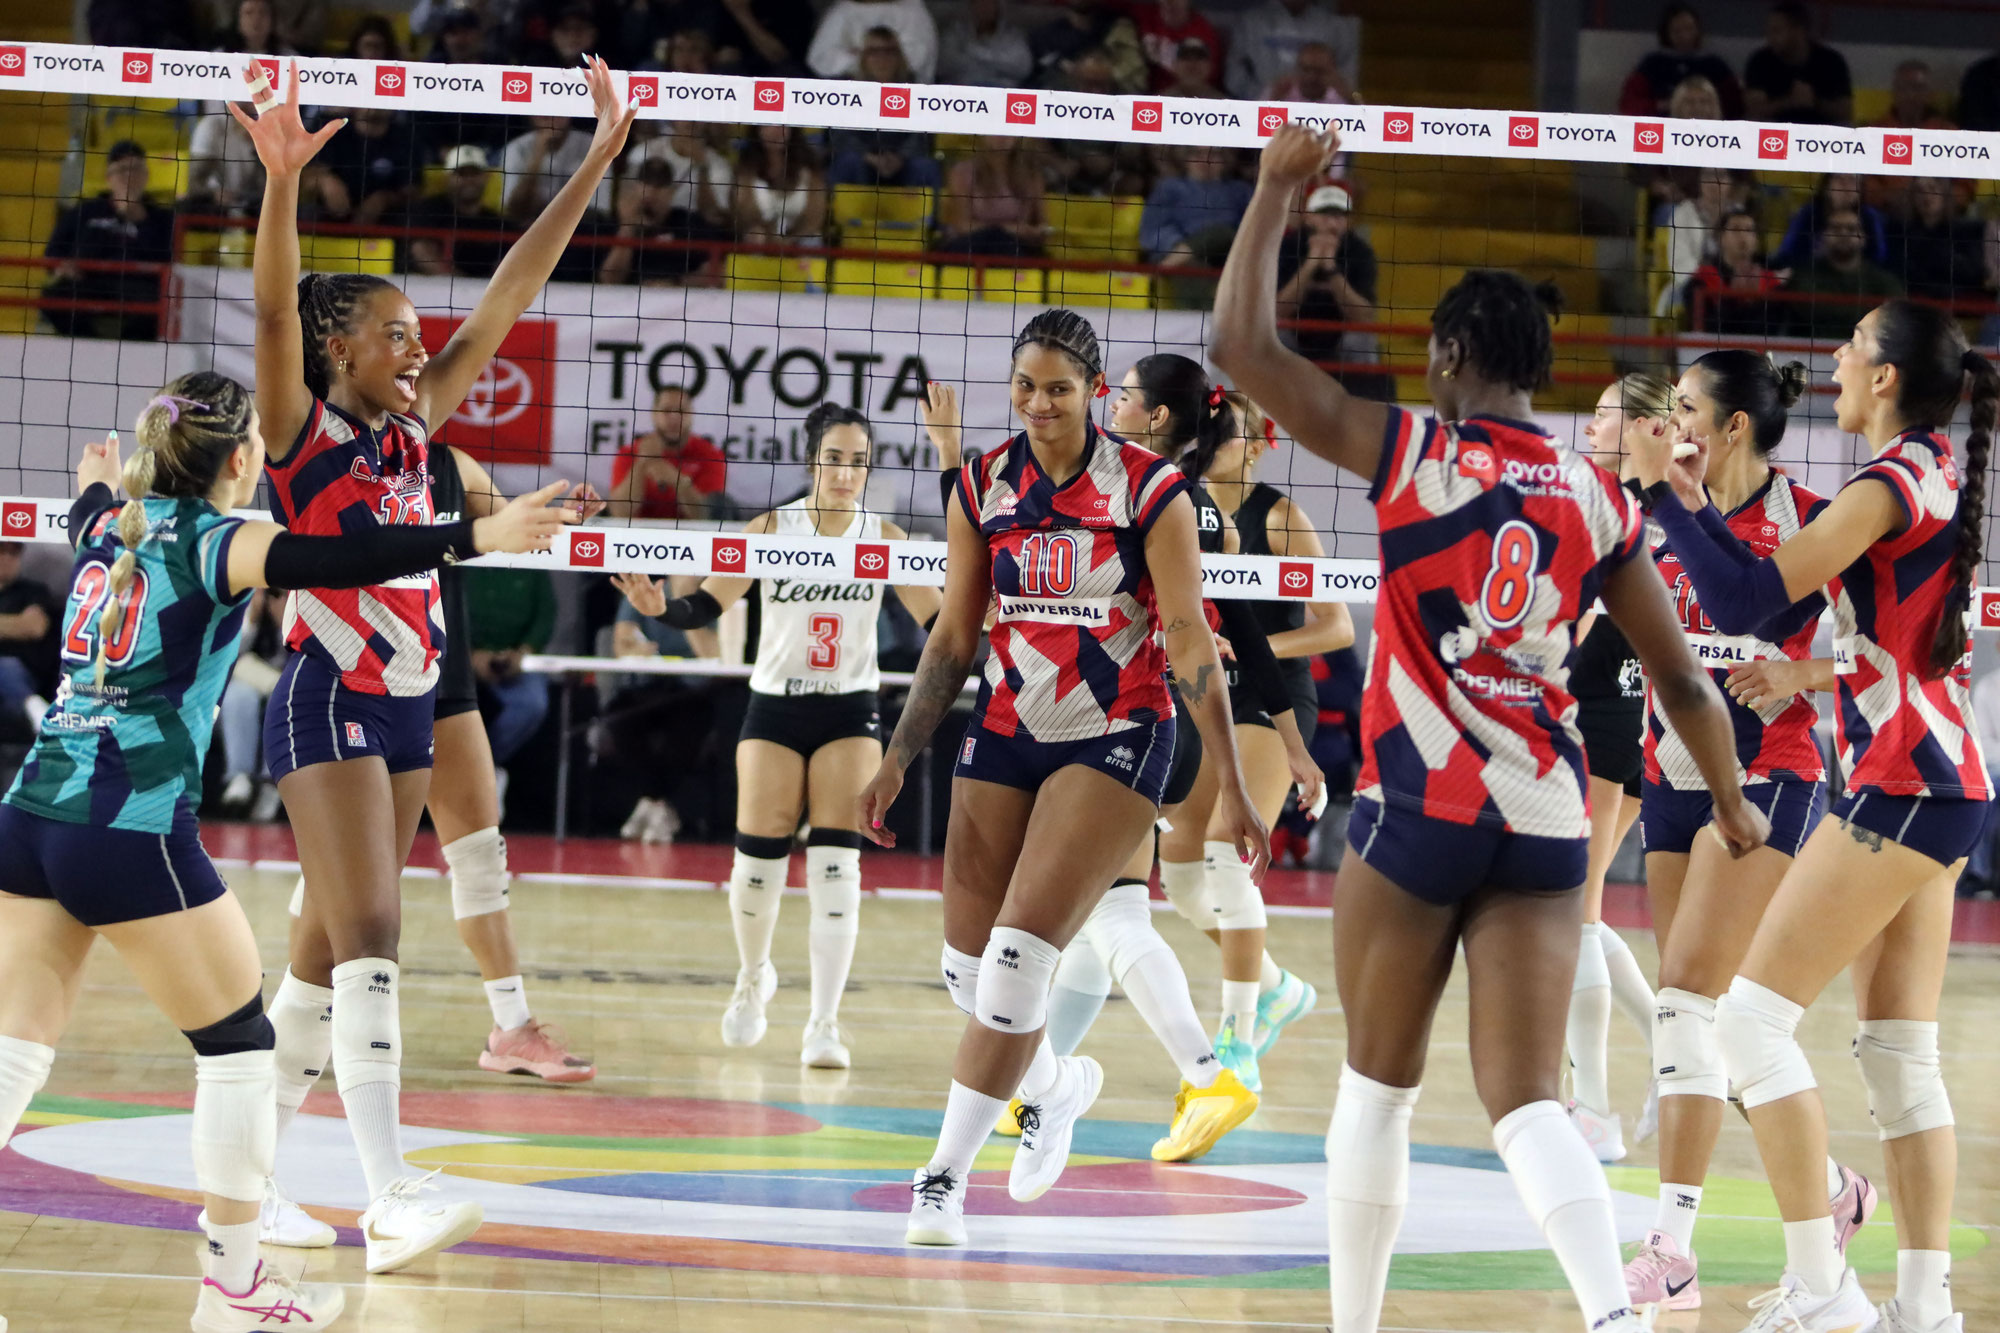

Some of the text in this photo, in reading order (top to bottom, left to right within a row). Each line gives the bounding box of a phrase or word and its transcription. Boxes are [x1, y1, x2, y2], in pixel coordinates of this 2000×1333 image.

[34, 56, 104, 72] TOYOTA
[161, 63, 231, 79] TOYOTA
[287, 69, 358, 87] OYOTA
[413, 76, 484, 91] TOYOTA
[540, 81, 588, 96] TOYO
[666, 85, 736, 101] TOYOTA
[792, 91, 862, 107] TOYOTA
[918, 98, 988, 113] TOYOTA
[1044, 104, 1114, 120] TOYOTA
[1170, 112, 1240, 127] TOYOTA
[1421, 122, 1491, 137] TOYOTA
[1546, 127, 1616, 142] TOYOTA
[1671, 133, 1740, 149] TOYOTA
[1796, 140, 1865, 155] TOYOTA
[1920, 145, 1989, 160] TOYOTA
[596, 341, 935, 413] TOYOTA
[614, 544, 694, 561] TOYOTA
[755, 550, 835, 567] TOYOTA
[898, 556, 947, 572] TOYO
[1322, 574, 1380, 590] TOYO
[1021, 532, 1077, 597] 10
[1481, 520, 1539, 630] 8
[61, 560, 150, 667] 20
[769, 578, 875, 604] Leonas
[1002, 603, 1103, 621] UNIVERSAL
[806, 612, 843, 671] 3
[1105, 755, 1133, 772] errea
[368, 984, 391, 995] errea
[997, 958, 1018, 970] errea
